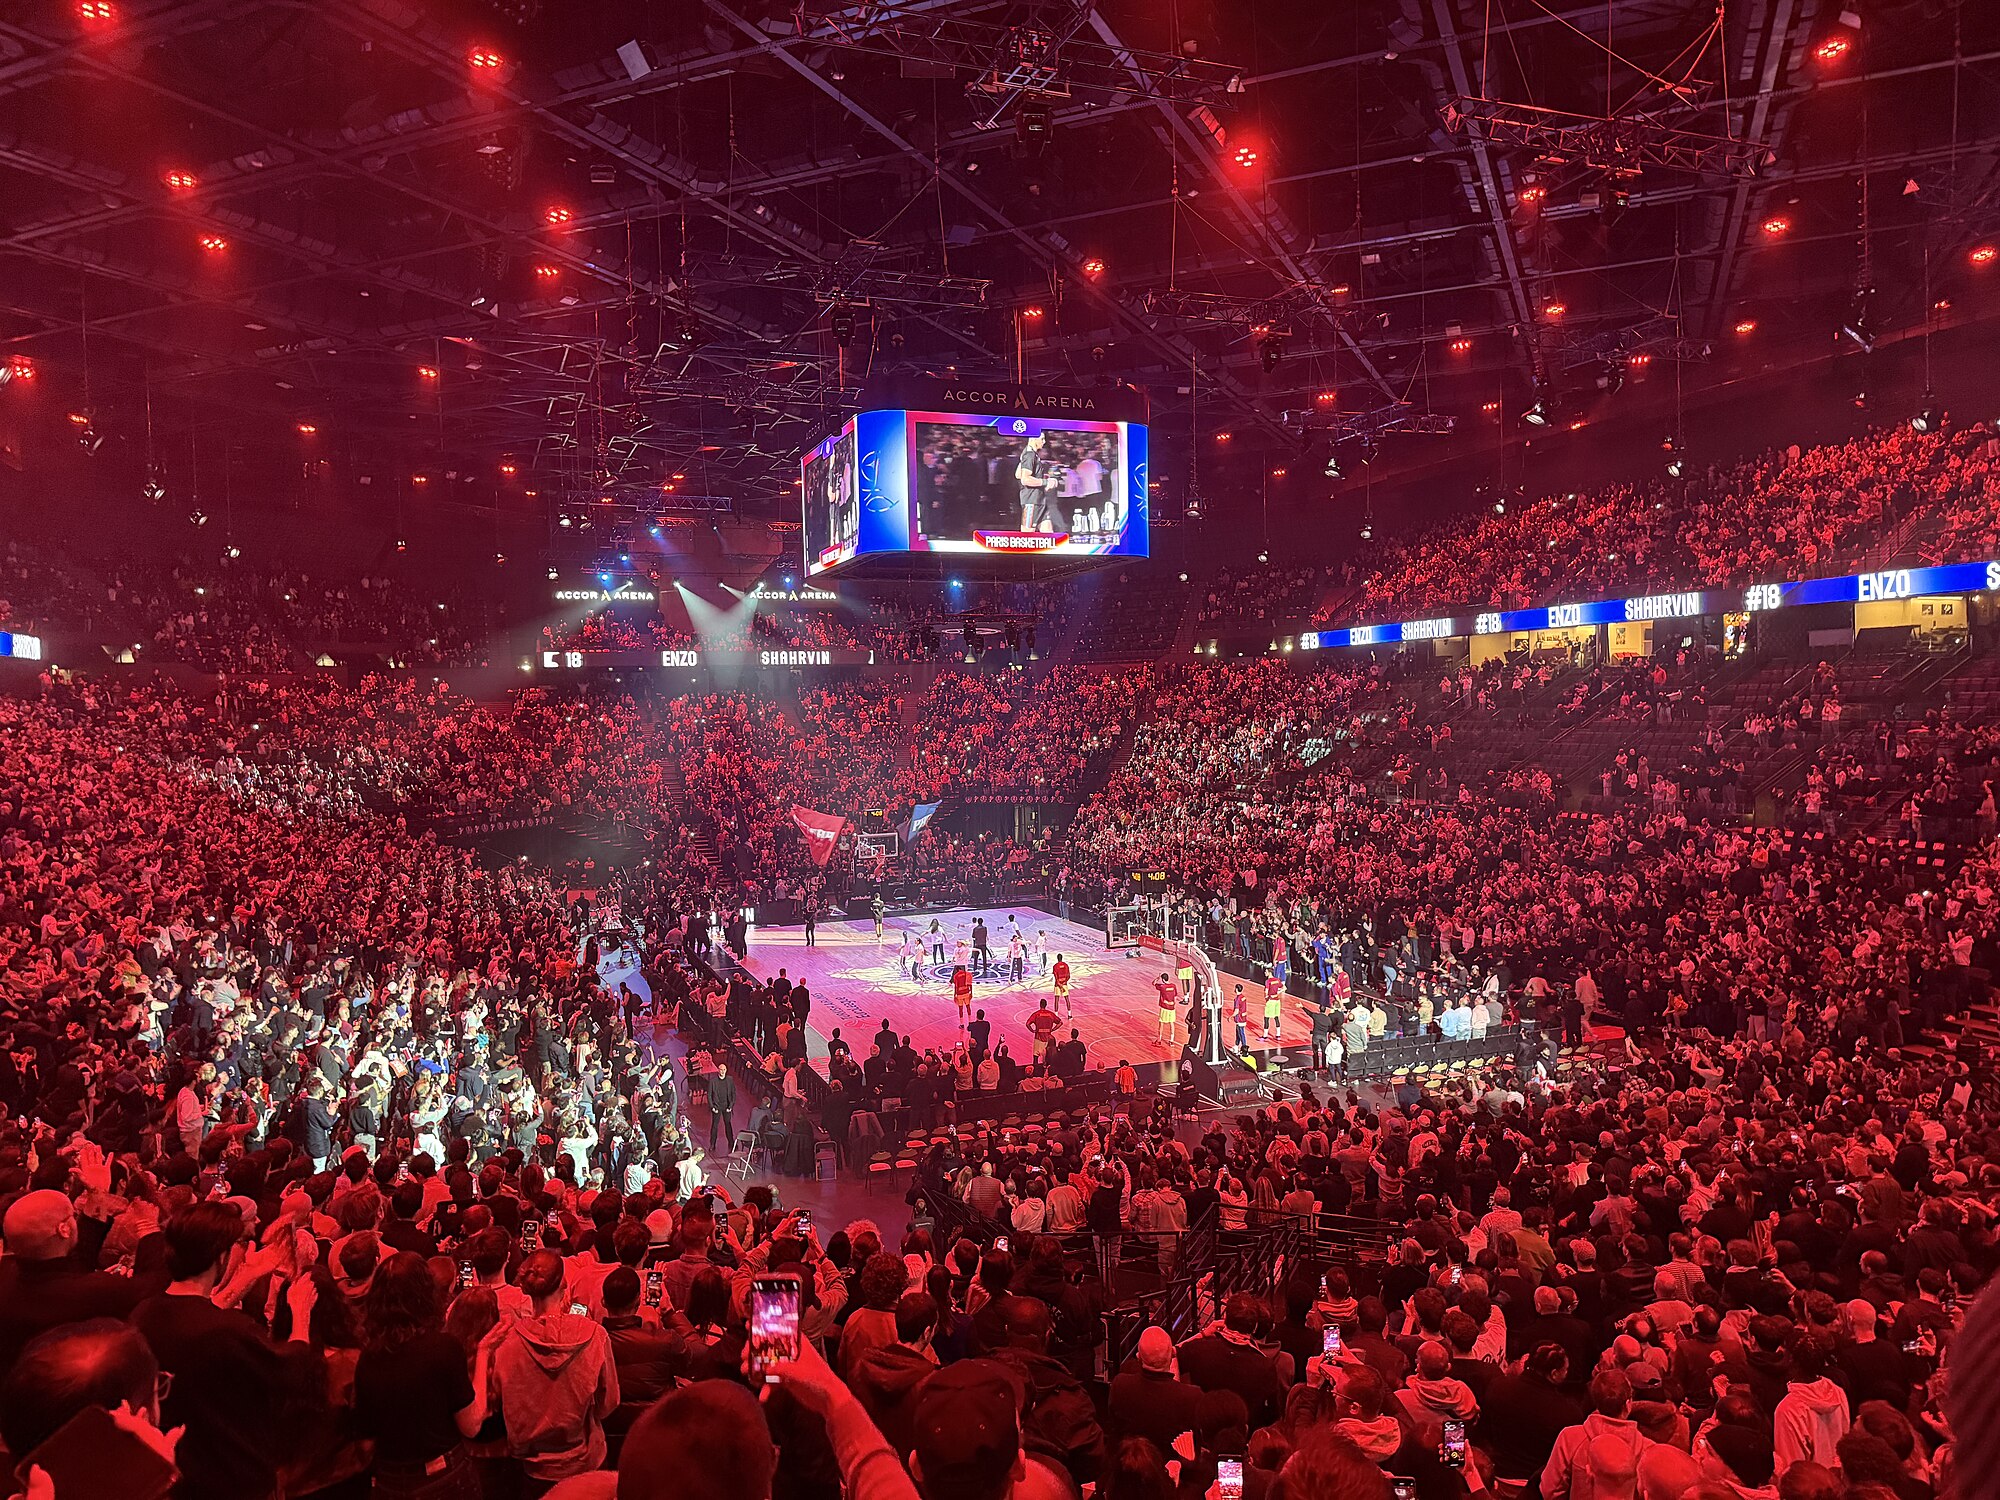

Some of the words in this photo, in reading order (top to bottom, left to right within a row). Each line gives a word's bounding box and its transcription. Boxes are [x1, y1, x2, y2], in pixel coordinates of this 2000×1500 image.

[943, 389, 1007, 405] ACCOR
[1034, 395, 1096, 410] ARENA
[985, 535, 1009, 549] PARIS
[1010, 535, 1058, 549] BASKETBALL
[555, 590, 598, 600] ACCOR
[613, 590, 655, 601] ARENA
[749, 590, 787, 600] ACCOR
[797, 590, 837, 601] ARENA
[1349, 626, 1373, 646] ENZO
[1401, 618, 1451, 641] SHAHRVIN
[1475, 613, 1502, 634] #18
[1548, 604, 1580, 628] ENZO
[1625, 592, 1700, 621] SHAHRVIN
[1745, 584, 1782, 611] #18
[1858, 570, 1911, 602] ENZO
[662, 651, 698, 667] ENZO
[761, 651, 830, 666] SHAHRVIN
